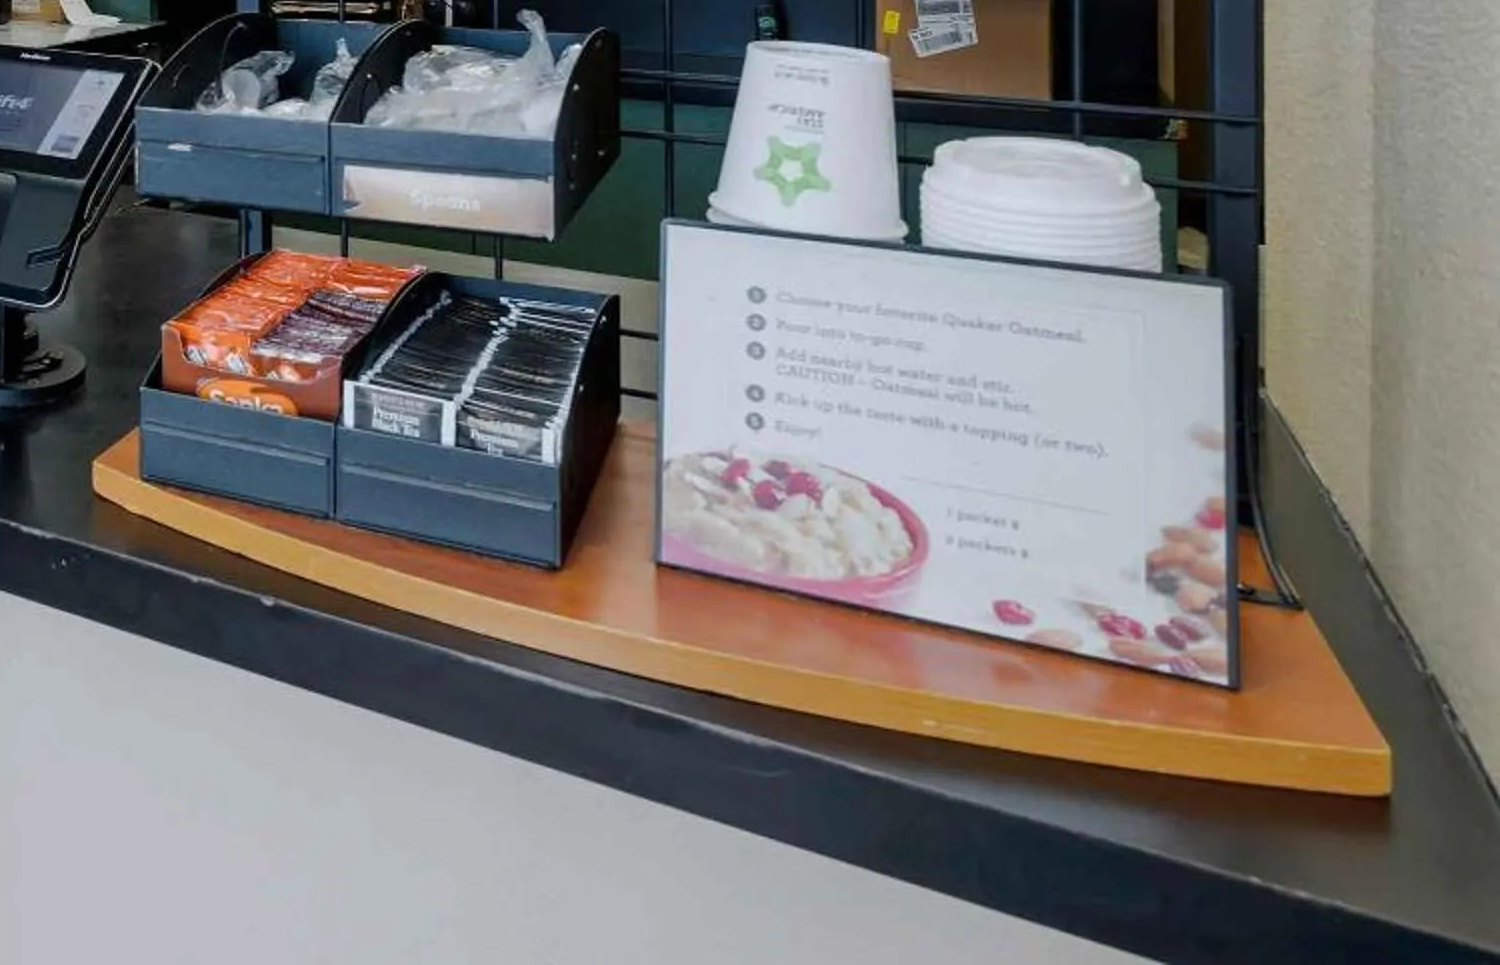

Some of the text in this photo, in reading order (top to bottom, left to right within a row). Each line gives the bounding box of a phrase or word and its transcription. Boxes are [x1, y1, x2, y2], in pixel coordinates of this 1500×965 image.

[409, 187, 481, 212] Spoons
[943, 311, 1004, 332] Quaker
[947, 374, 978, 389] and
